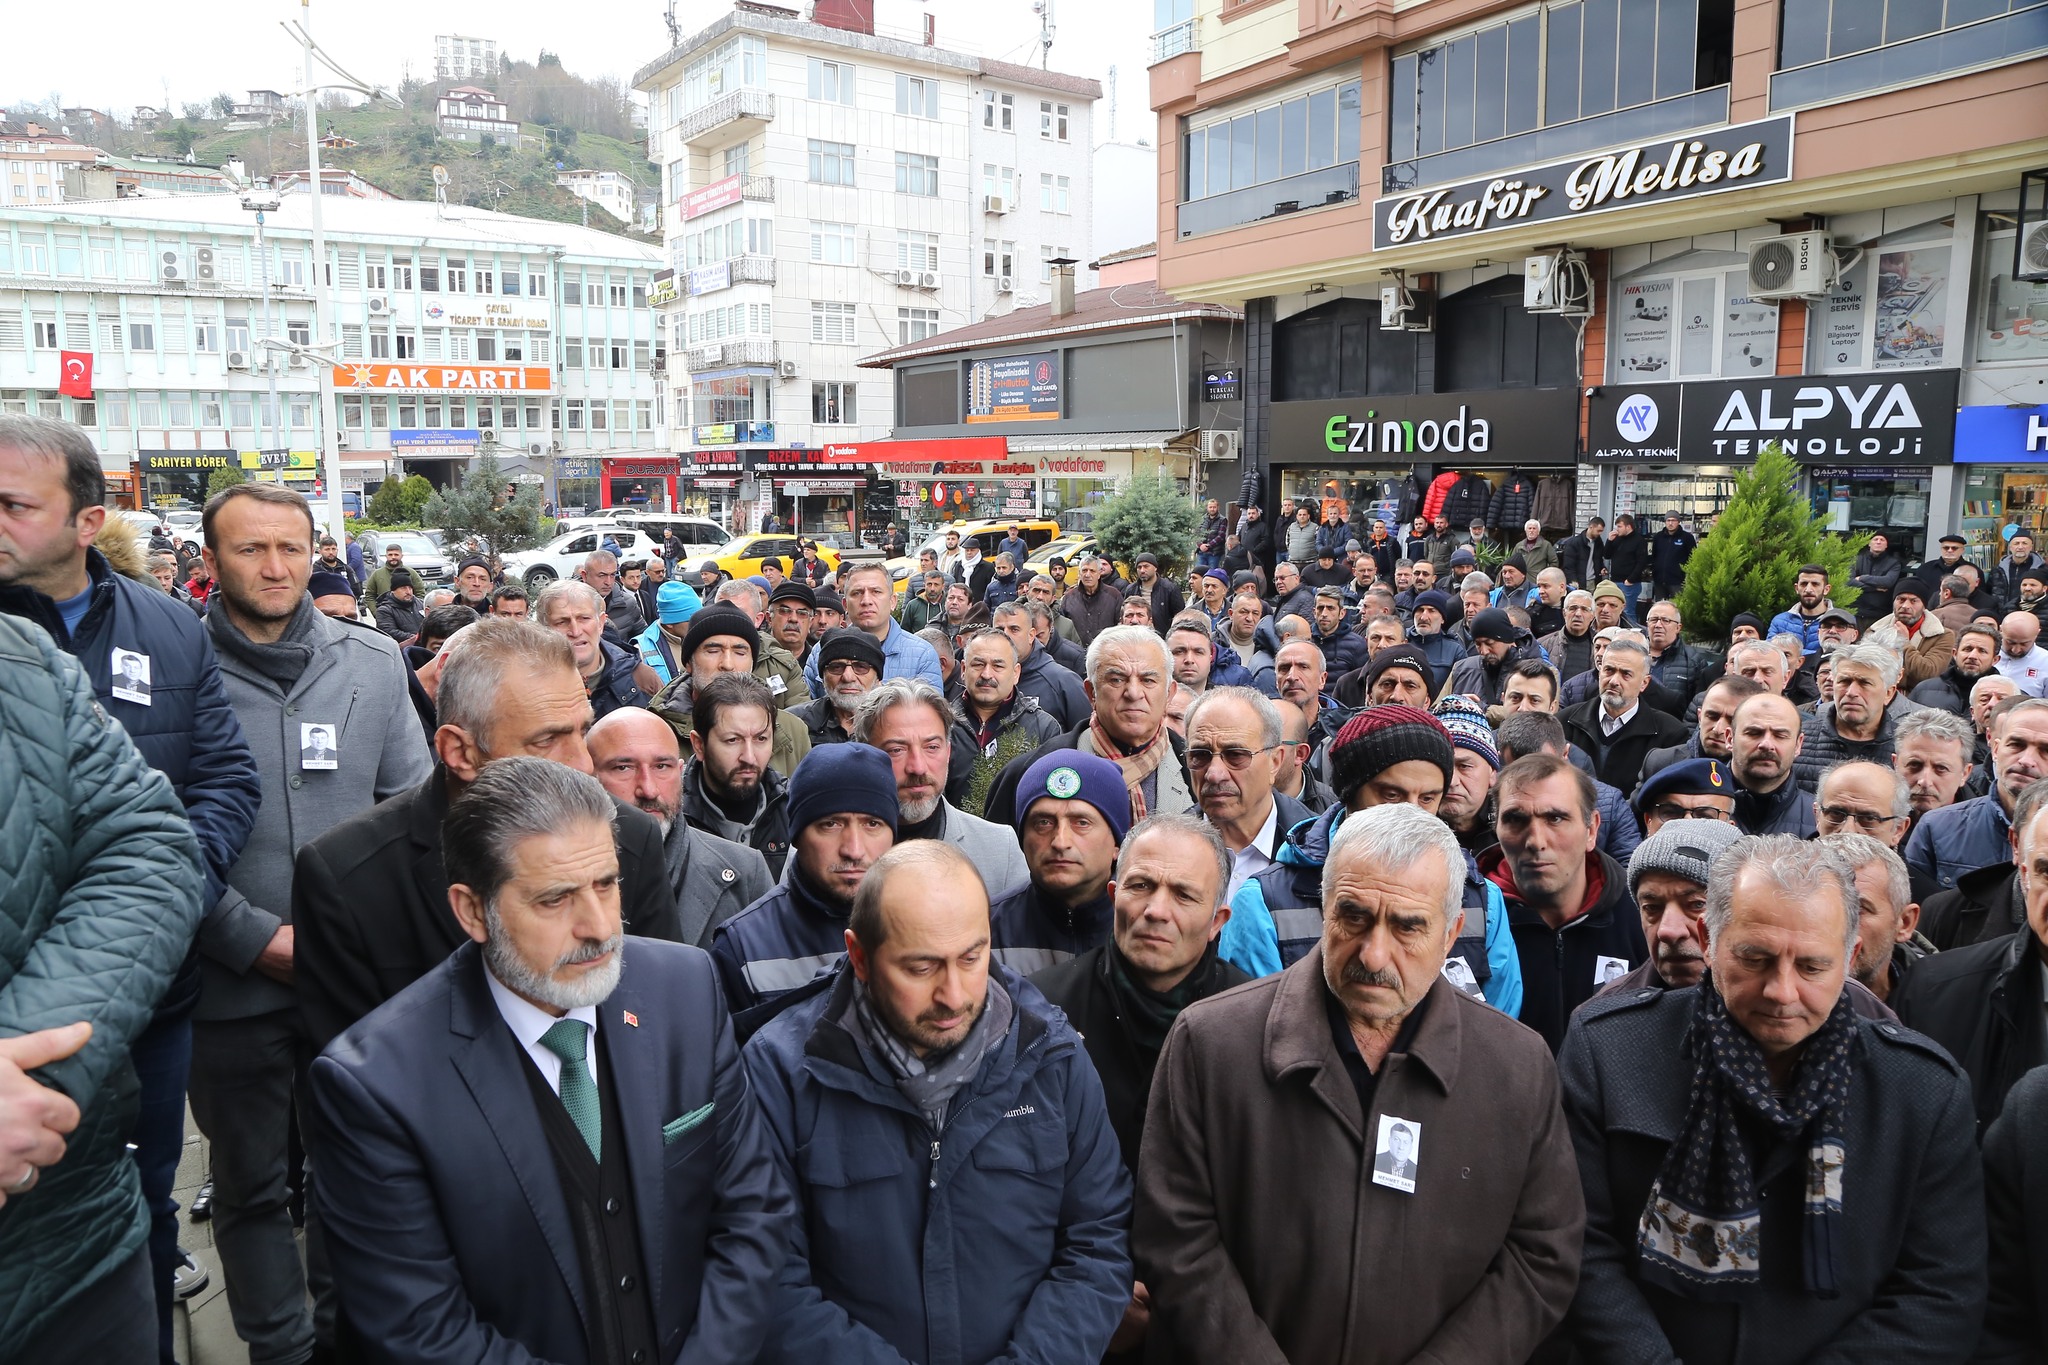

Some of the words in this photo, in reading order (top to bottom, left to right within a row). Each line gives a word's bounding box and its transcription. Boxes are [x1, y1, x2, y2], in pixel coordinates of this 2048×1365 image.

[1387, 179, 1549, 242] Kuaför
[1565, 141, 1763, 212] Melisa
[1800, 237, 1809, 271] BOSCH
[1624, 282, 1673, 295] HIKVISION
[1831, 294, 1862, 304] TEKNİK
[486, 303, 512, 315] ÇAYELİ
[1830, 303, 1860, 312] SERVİS
[450, 314, 482, 326] TİCARET
[484, 317, 495, 327] VE
[1827, 331, 1860, 340] Bilgisayar
[385, 367, 430, 388] AK
[441, 366, 526, 389] PARTİ
[1713, 383, 1923, 432] ALPYA
[415, 446, 428, 454] AK
[431, 446, 458, 454] PARTİ
[834, 446, 858, 455] vodafone
[1595, 448, 1634, 458] ALPYA
[1637, 446, 1678, 457] TEKNİK
[150, 456, 192, 468] SARIYER
[195, 454, 227, 468] BÖREK
[260, 452, 288, 465] EVET
[565, 458, 588, 468] ethica
[625, 464, 677, 476] DURAK
[754, 462, 778, 471] YÖRESEL
[816, 462, 837, 471] FABRİKA
[840, 463, 854, 471] SATIŞ
[889, 461, 931, 474] vodafone
[1048, 457, 1105, 473] vodafone
[899, 480, 908, 492] 12
[908, 480, 918, 492] AY
[1003, 479, 1032, 489] VODAFONE
[1010, 489, 1025, 498] EVDE
